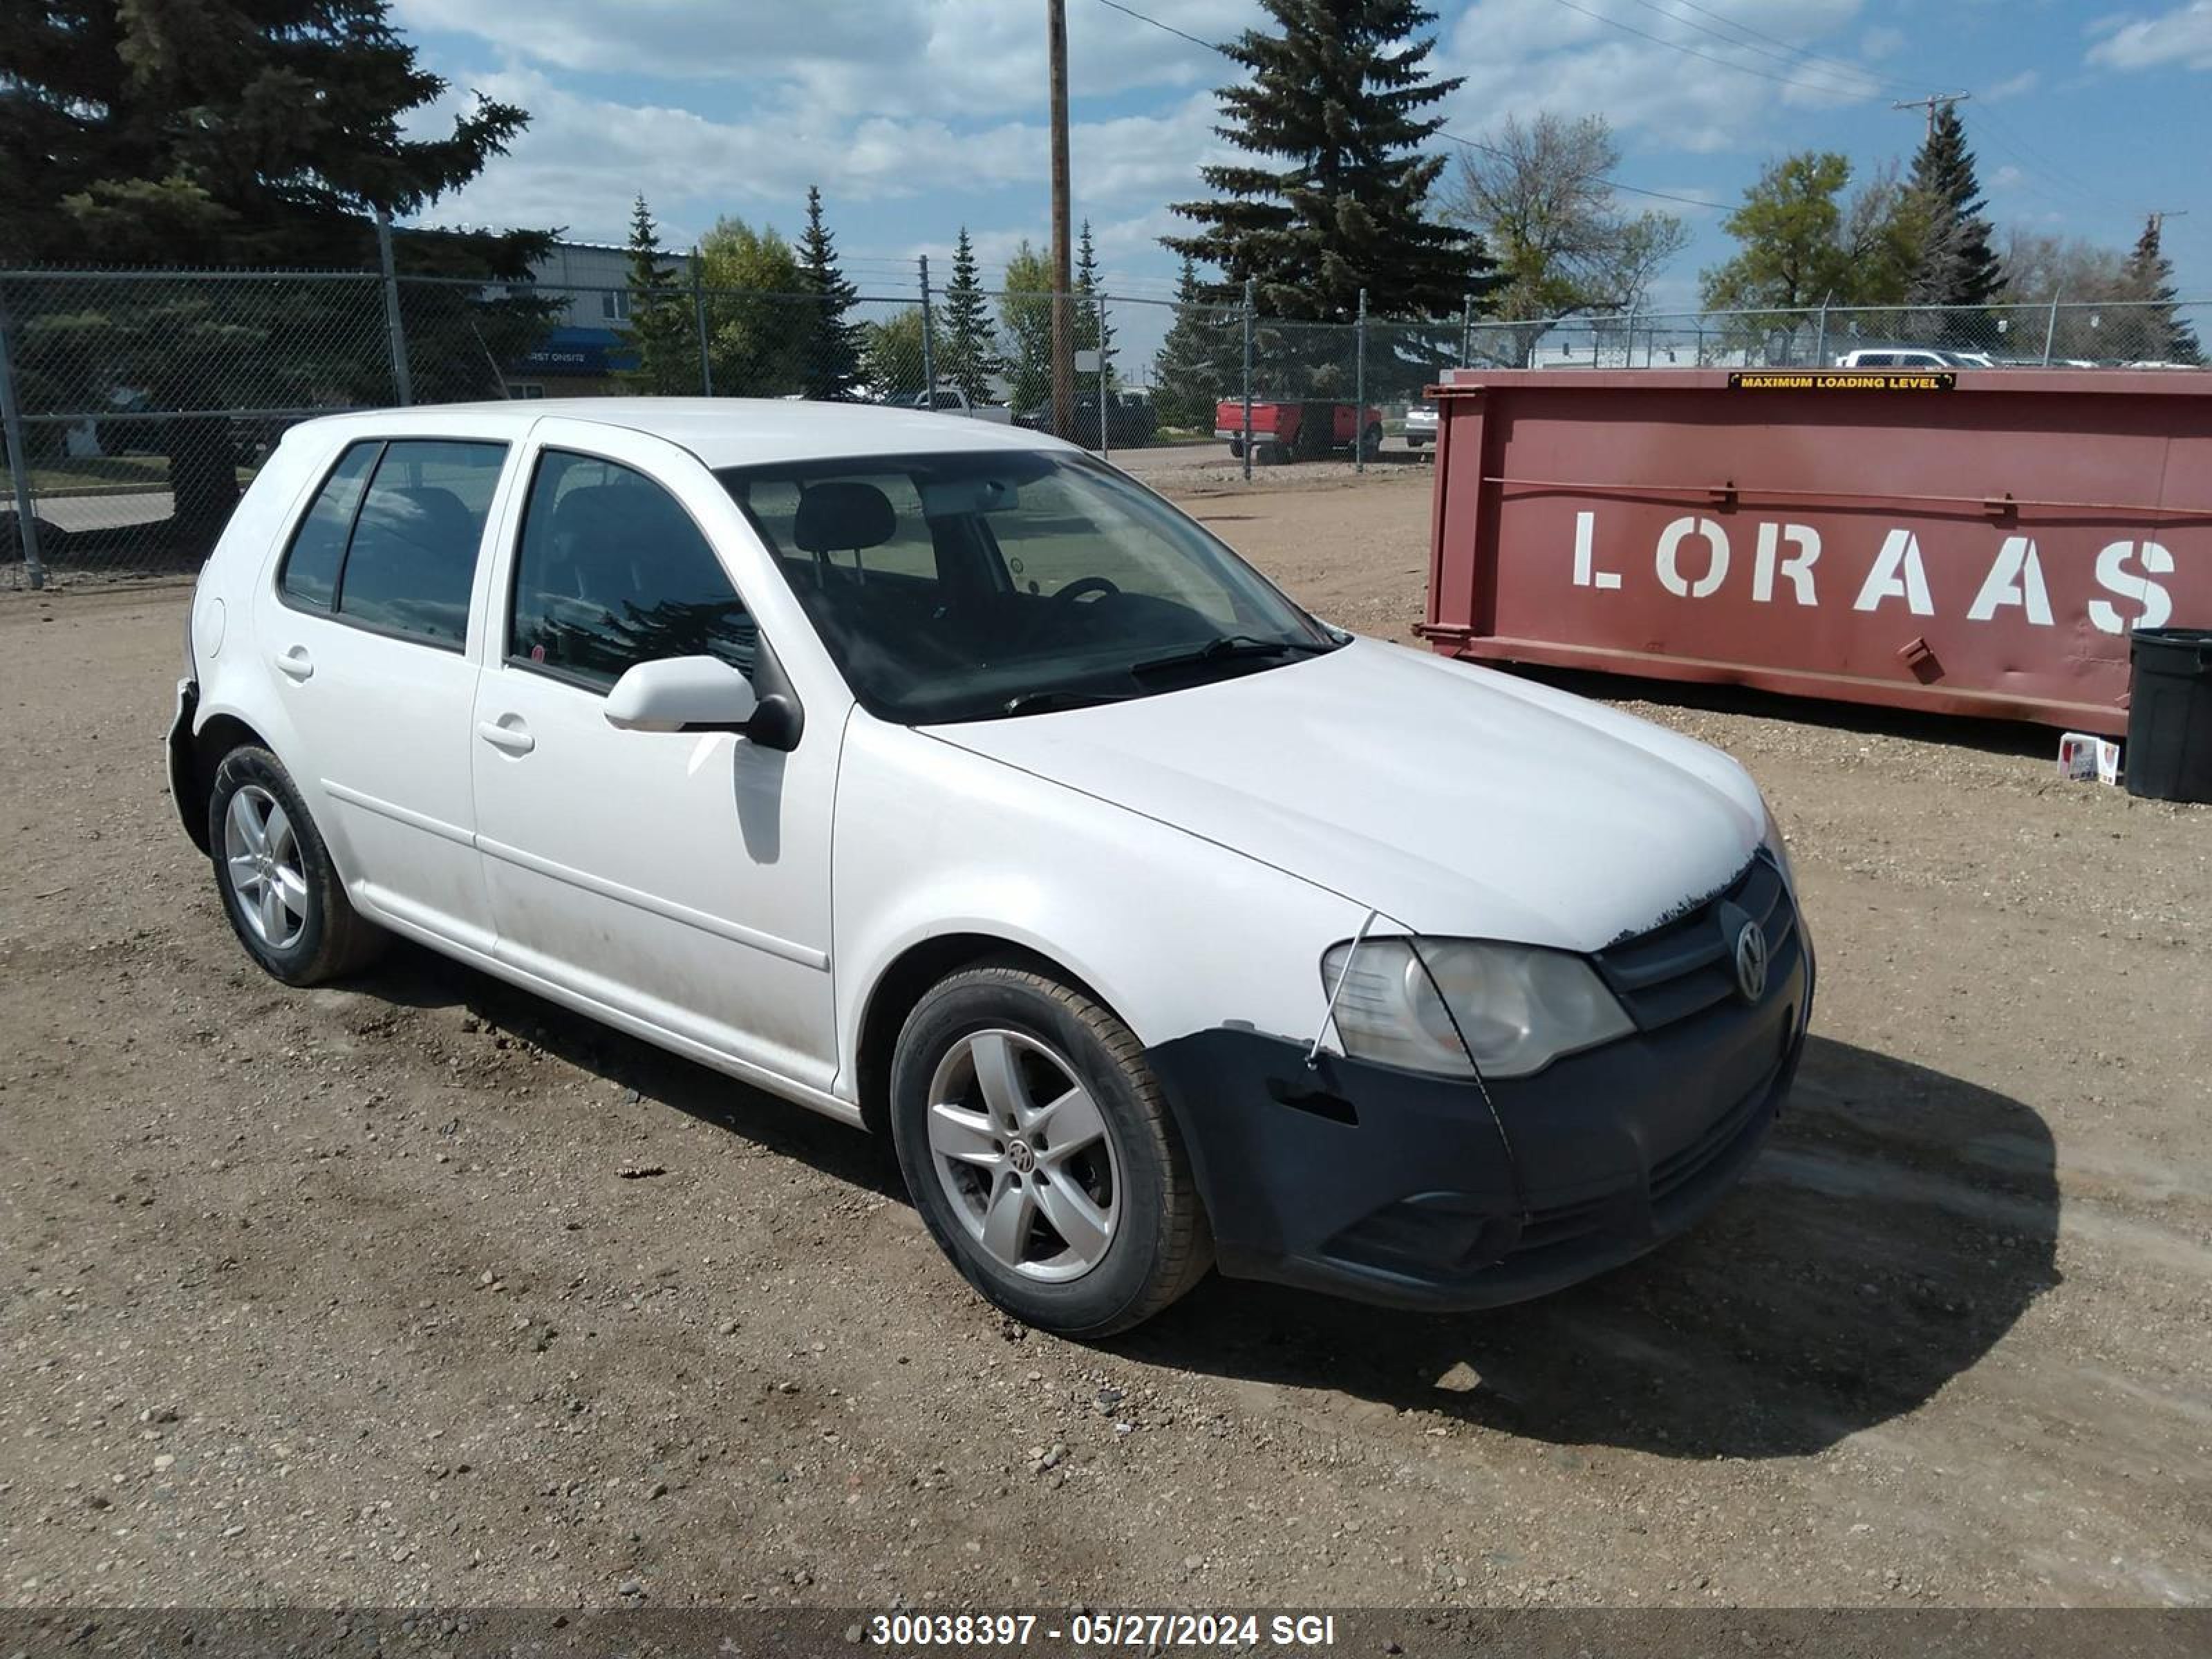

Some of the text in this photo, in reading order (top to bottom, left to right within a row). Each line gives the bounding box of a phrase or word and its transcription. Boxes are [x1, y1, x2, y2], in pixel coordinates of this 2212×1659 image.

[1741, 377, 1940, 388] MAXIMUM LOADING LEVEL
[1572, 510, 2176, 636] LORAAS
